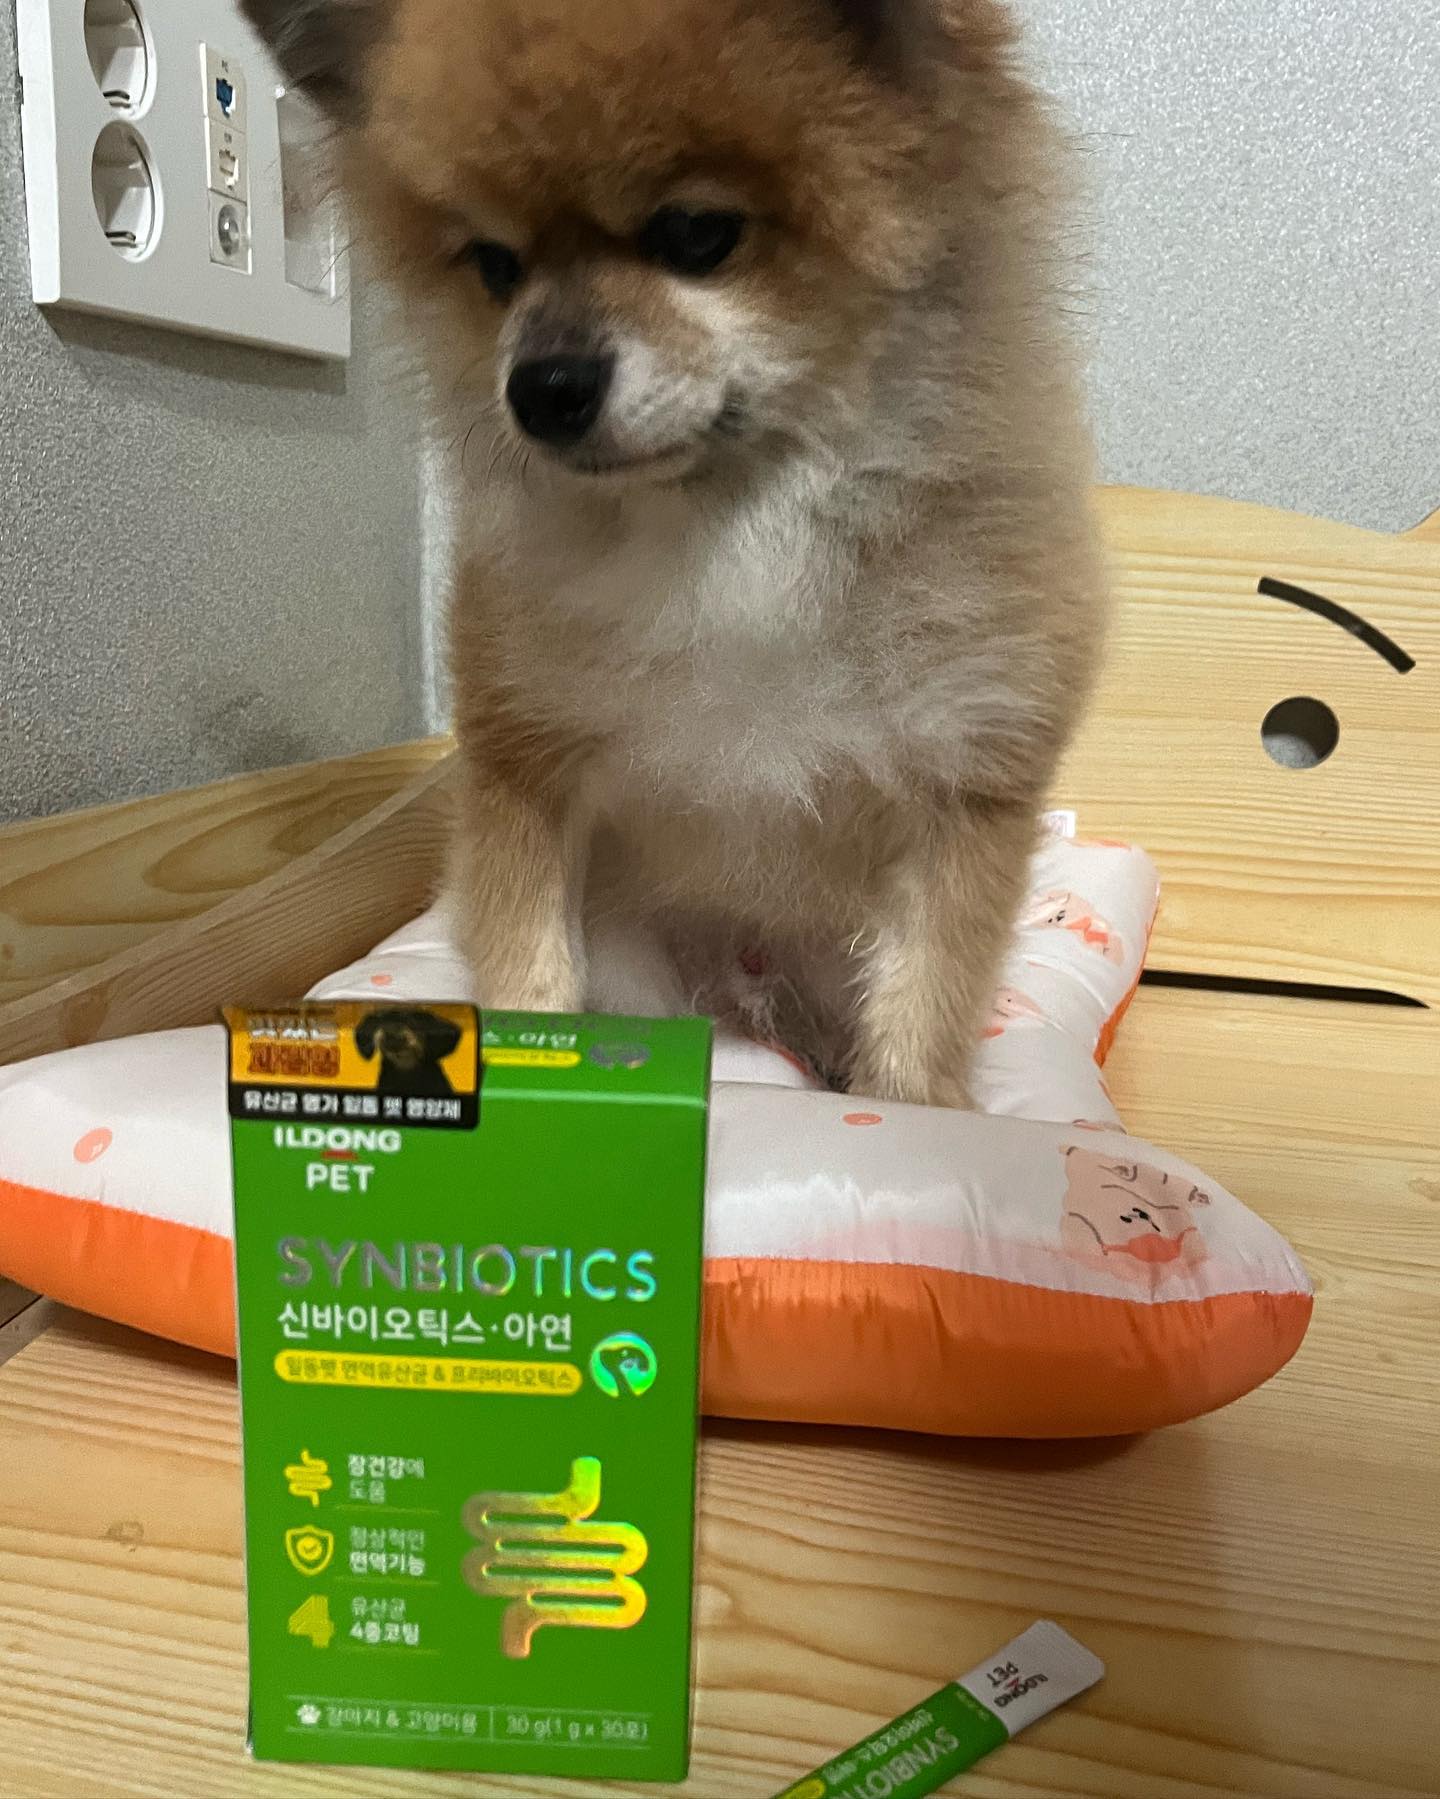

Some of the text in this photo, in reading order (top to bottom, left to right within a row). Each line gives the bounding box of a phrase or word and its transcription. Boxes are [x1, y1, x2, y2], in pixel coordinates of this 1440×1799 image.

[274, 1125, 402, 1153] ILDONG
[306, 1162, 375, 1192] PET
[278, 1236, 657, 1302] SYNBIOTICS
[278, 1302, 572, 1352] 신바이오틱스·아연
[350, 1551, 426, 1576] 면역기능
[986, 1661, 1019, 1687] PET
